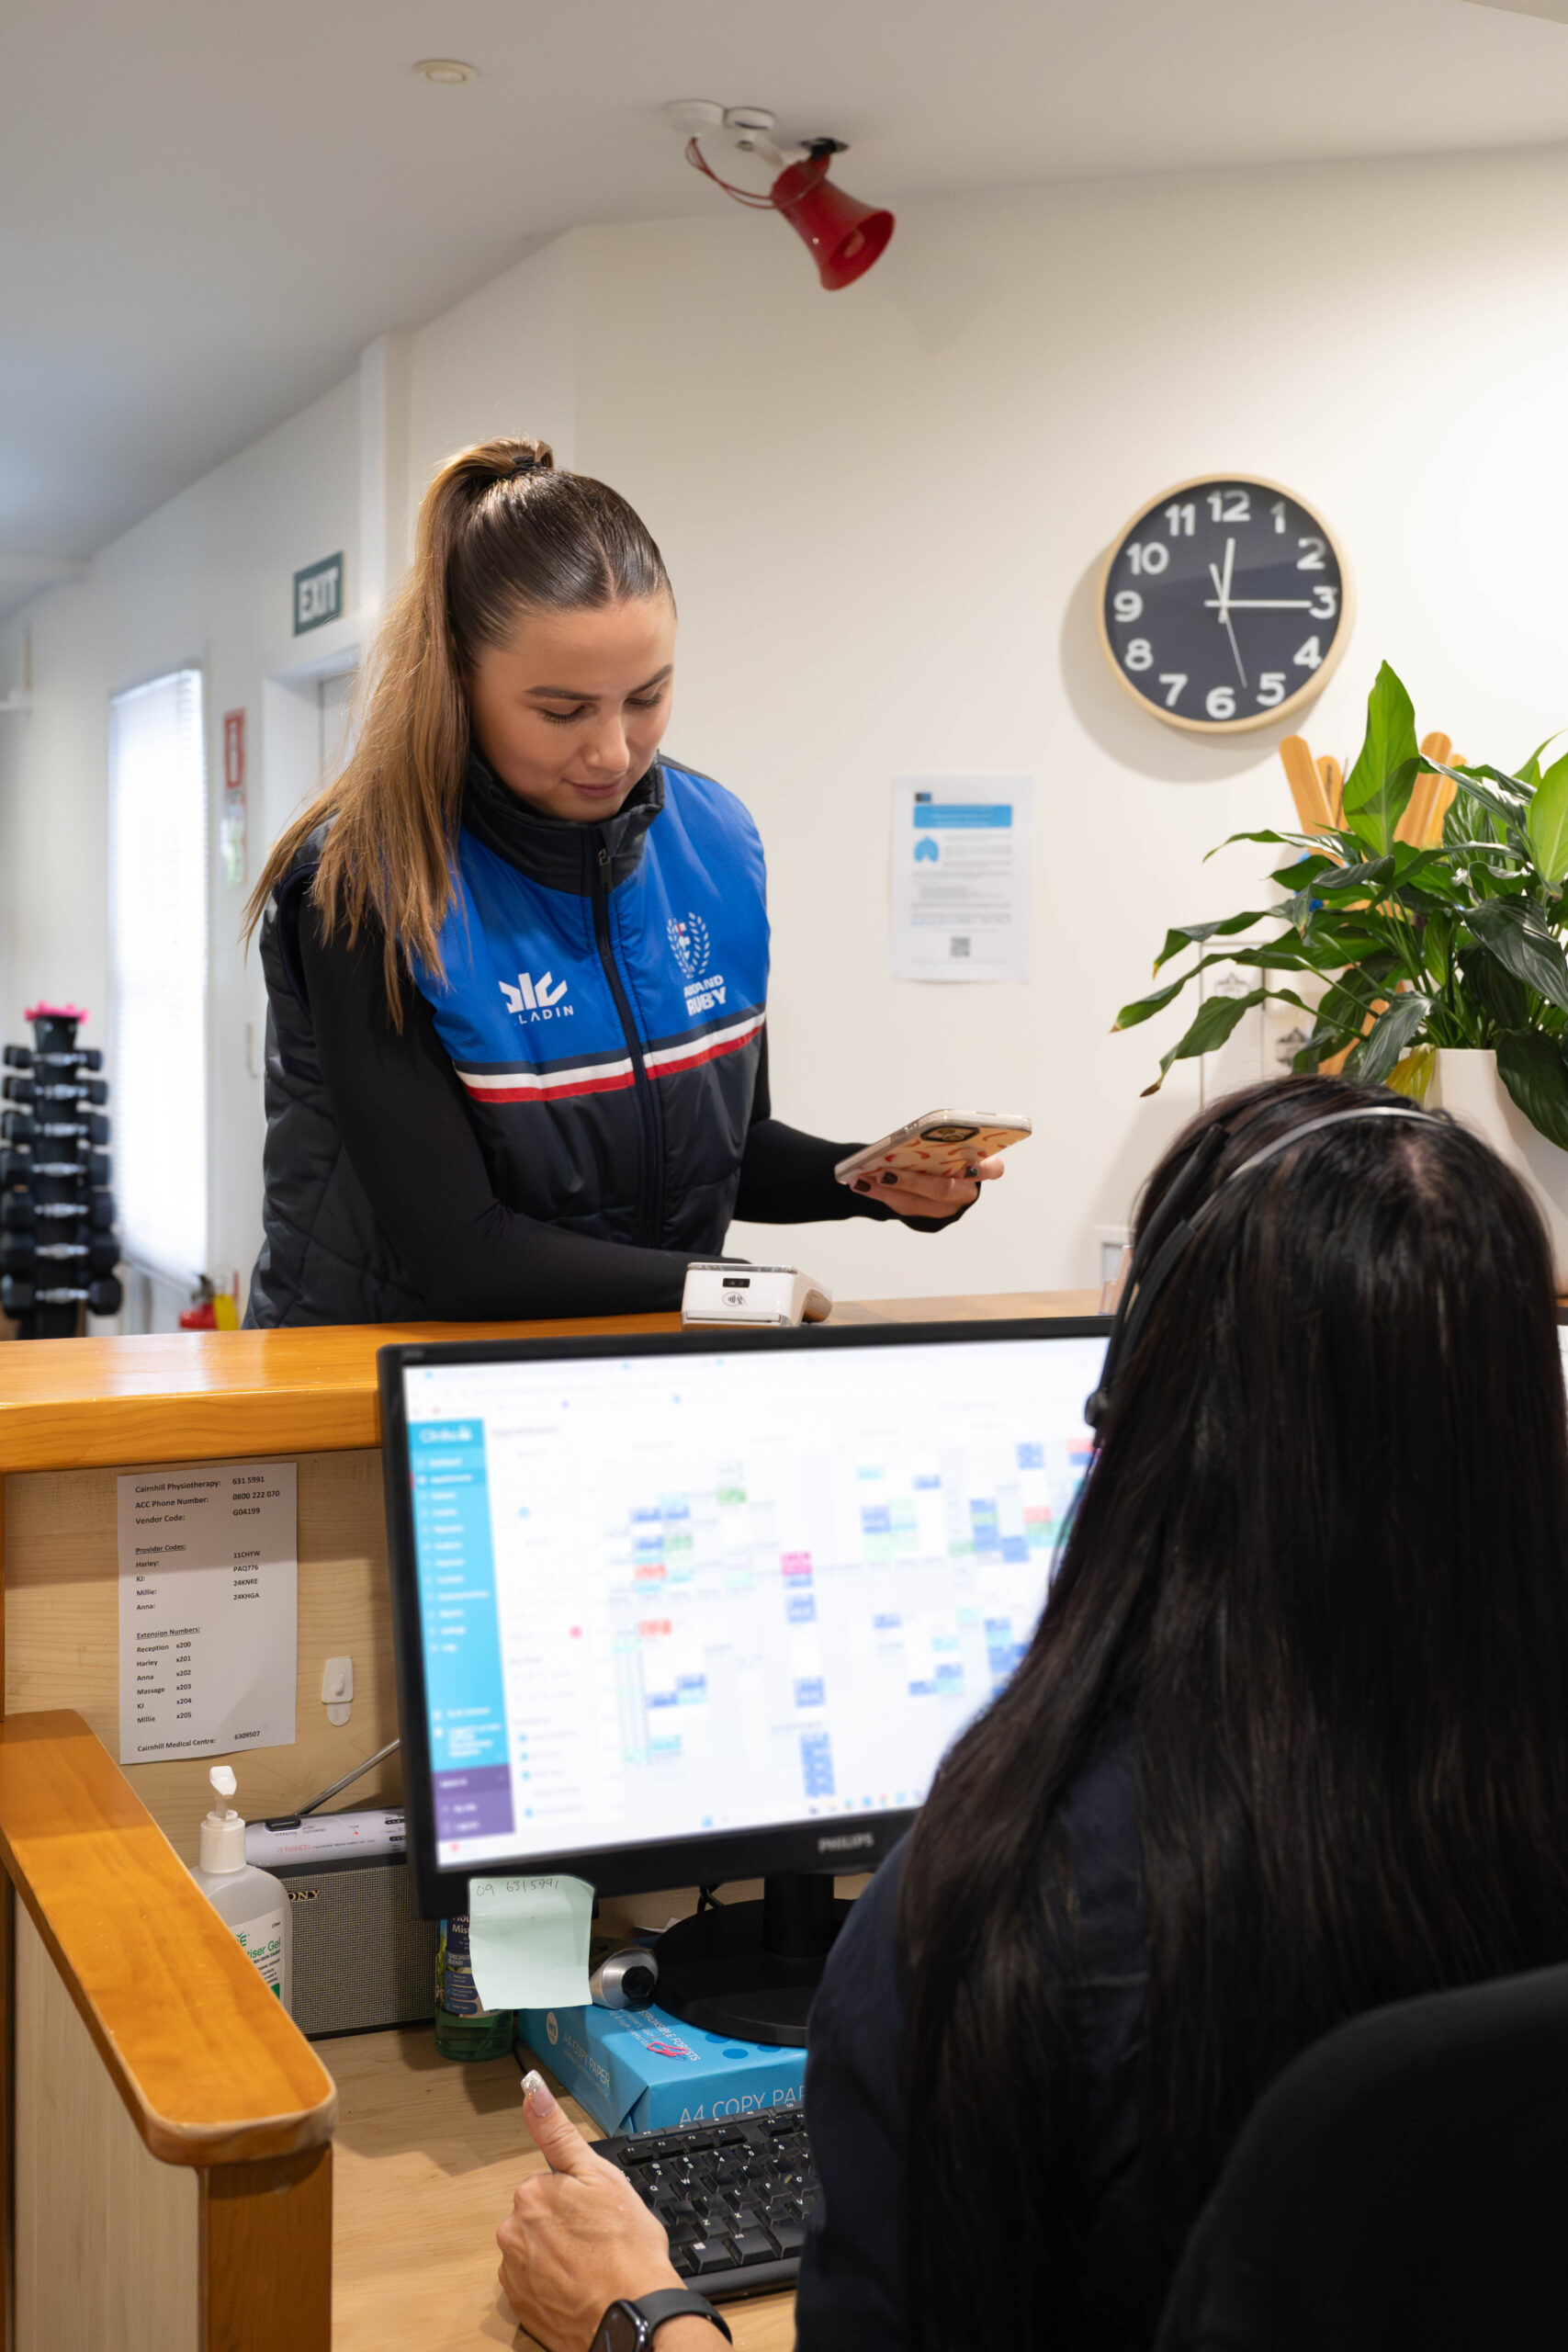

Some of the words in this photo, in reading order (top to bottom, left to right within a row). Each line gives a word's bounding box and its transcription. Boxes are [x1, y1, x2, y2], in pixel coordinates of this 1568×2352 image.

[1207, 490, 1250, 522] 12
[1165, 503, 1195, 537] 11
[1271, 502, 1285, 534] 1
[1126, 542, 1169, 575] 10
[1297, 537, 1325, 570] 2
[299, 566, 339, 625] EXIT
[1309, 585, 1337, 619] 3
[1113, 591, 1143, 622] 9
[1124, 639, 1154, 671] 8
[1293, 636, 1323, 670] 4
[1159, 673, 1188, 707] 7
[1257, 673, 1286, 707] 5
[1205, 686, 1235, 719] 6
[518, 1005, 574, 1025] LADIN
[135, 1484, 165, 1494] Cairnhill
[166, 1480, 222, 1492] Physiotherapy:
[232, 1477, 246, 1486] 631
[247, 1476, 265, 1485] 5991
[135, 1501, 151, 1510] ACC
[152, 1498, 175, 1509] Phone
[176, 1497, 209, 1506] Number:
[232, 1492, 251, 1501] 0800
[252, 1491, 265, 1499] 222
[266, 1489, 280, 1498] 070
[135, 1516, 163, 1525] Vendor
[164, 1514, 186, 1523] Code:
[232, 1507, 261, 1516] G04199
[135, 1545, 164, 1555] Provider
[164, 1544, 186, 1553] Codes:
[135, 1560, 160, 1569] Harley:
[136, 1588, 157, 1597] Millie:
[136, 1602, 156, 1611] Anna:
[136, 1630, 168, 1640] Extension
[169, 1626, 201, 1635] Numbers:
[136, 1644, 169, 1654] Reception
[175, 1641, 192, 1649] x200
[136, 1659, 158, 1668] Harley
[175, 1655, 191, 1663] x201
[137, 1686, 165, 1696] Massage
[175, 1683, 192, 1691] x203
[175, 1697, 192, 1705] x204
[137, 1715, 156, 1724] Millie
[175, 1712, 192, 1720] x205
[137, 1743, 164, 1753] Cairnhill
[165, 1739, 192, 1749] Medical
[192, 1737, 217, 1747] Centre:
[818, 1831, 882, 1857] PHILIPS
[288, 1889, 321, 1902] ONY
[476, 1883, 495, 1897] 09
[452, 1924, 469, 1934] Mis
[267, 1936, 281, 1951] Gel
[589, 2057, 611, 2088] PAPER
[680, 2104, 705, 2125] A4
[712, 2092, 766, 2120] COPY
[773, 2085, 807, 2107] PAP
[734, 2211, 742, 2220] X
